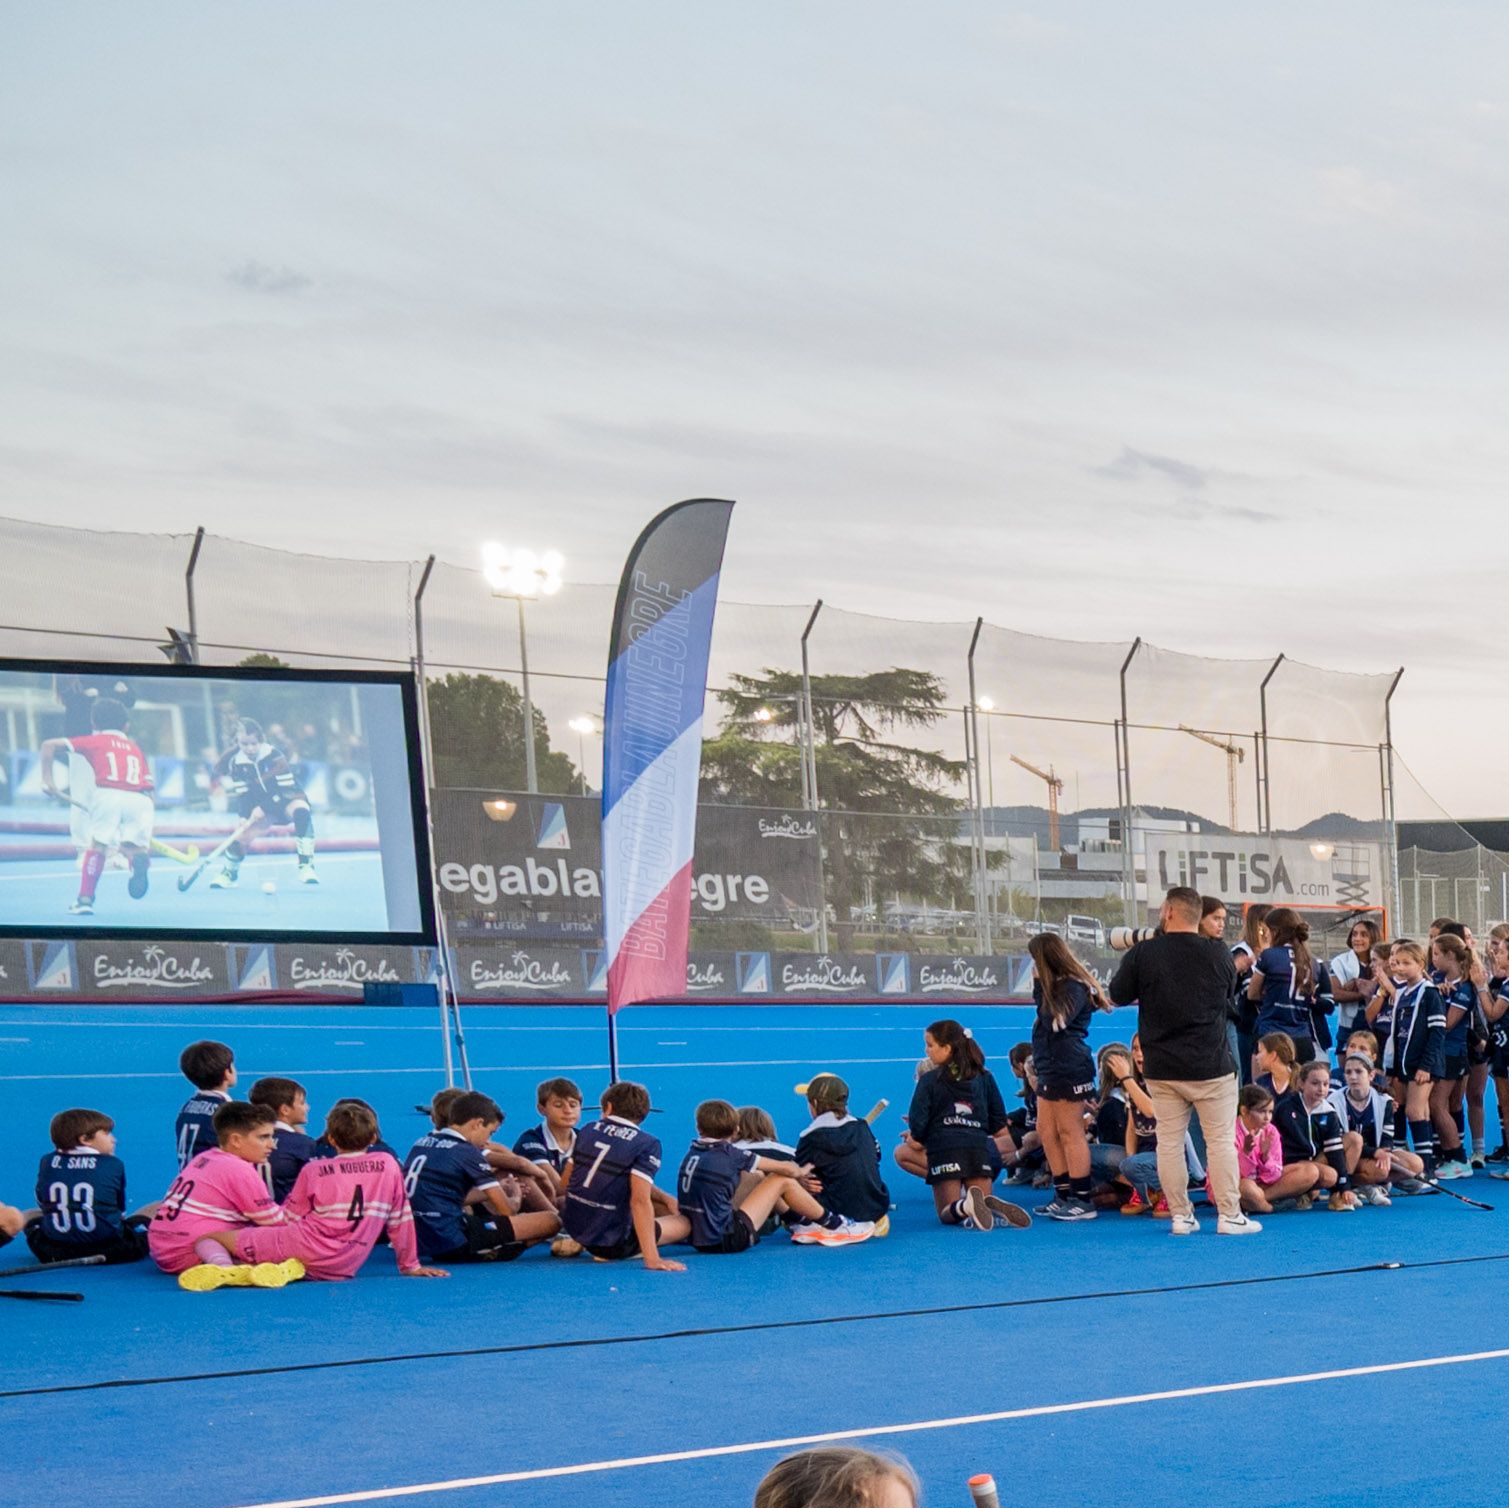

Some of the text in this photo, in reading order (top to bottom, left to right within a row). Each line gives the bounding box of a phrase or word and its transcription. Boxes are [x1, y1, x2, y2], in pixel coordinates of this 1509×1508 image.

[439, 858, 601, 904] egabla
[67, 1155, 97, 1169] SANS
[318, 1160, 386, 1178] JAN NOGUERAS
[583, 1141, 611, 1188] 7
[682, 1155, 700, 1194] 9
[49, 1182, 97, 1233] 33
[347, 1184, 364, 1233] 4
